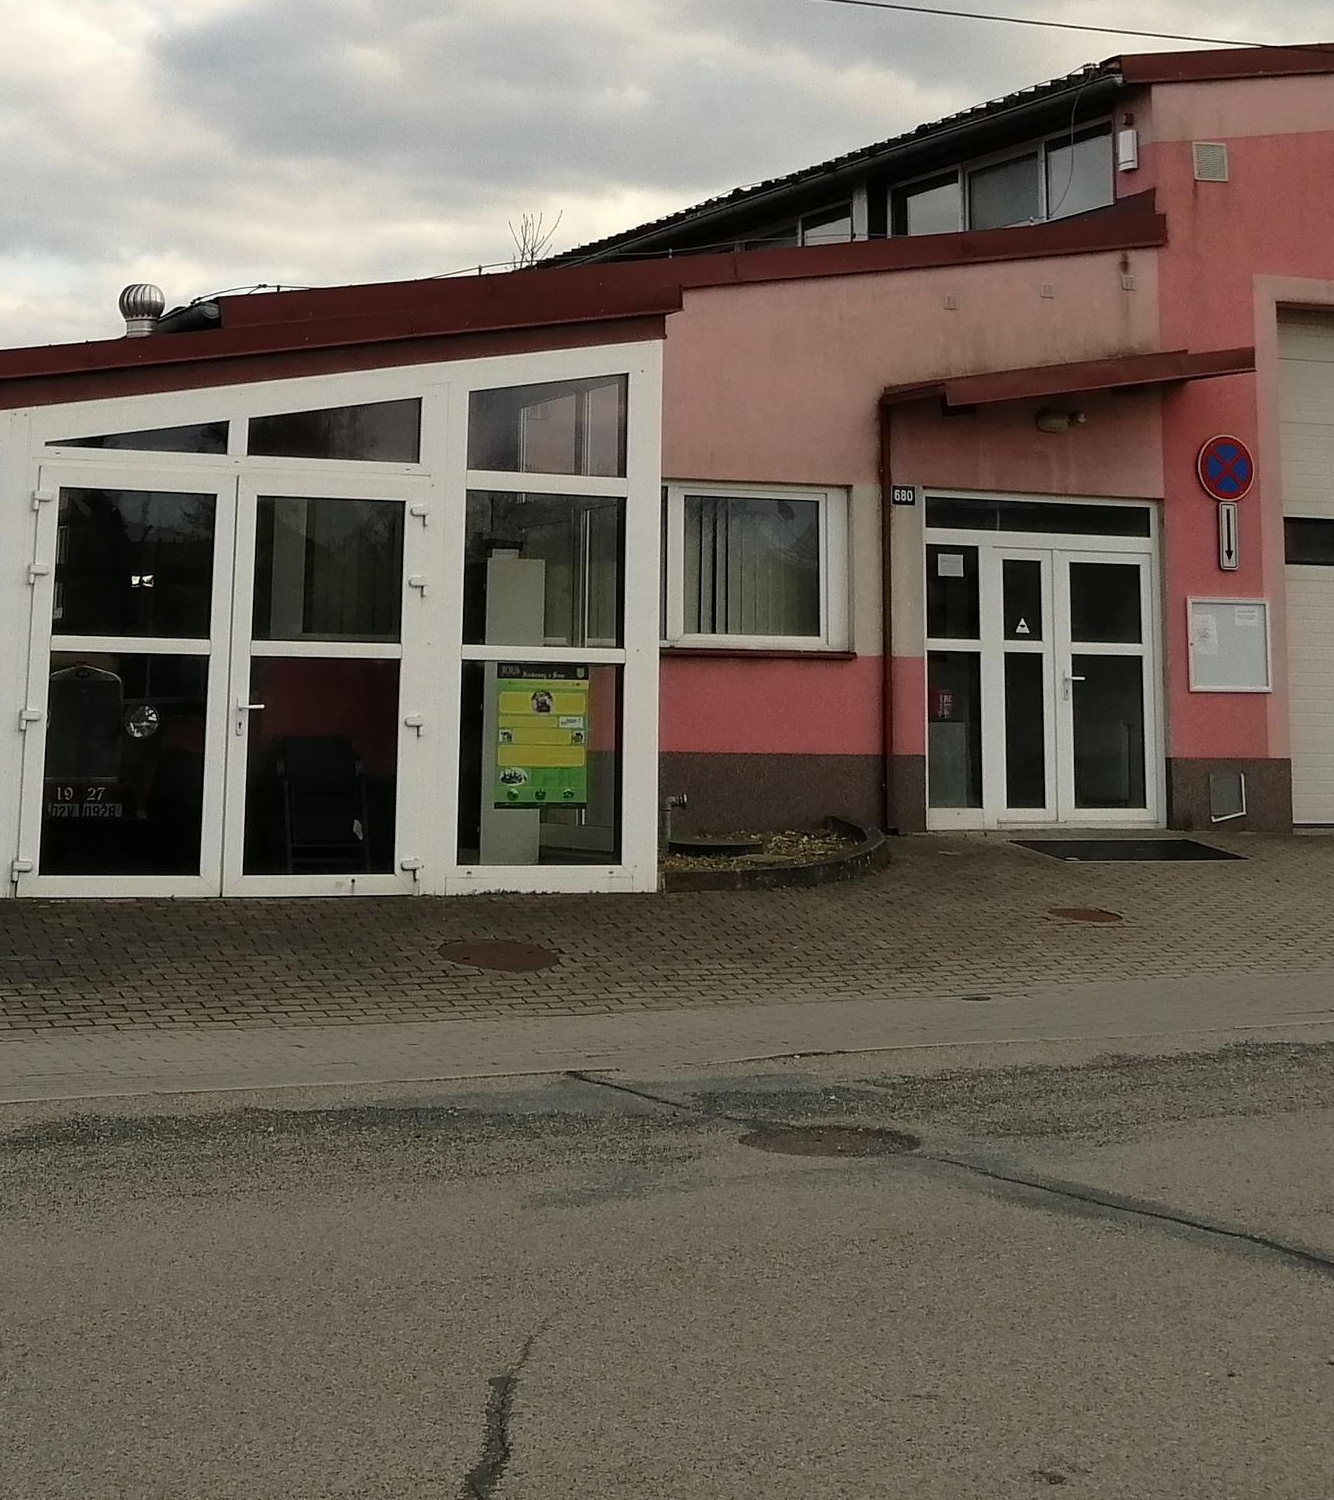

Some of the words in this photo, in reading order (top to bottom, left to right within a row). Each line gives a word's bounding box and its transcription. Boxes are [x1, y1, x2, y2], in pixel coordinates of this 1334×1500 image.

[894, 489, 913, 501] 680
[57, 787, 73, 800] 19
[87, 787, 105, 801] 27
[84, 805, 116, 819] 0928
